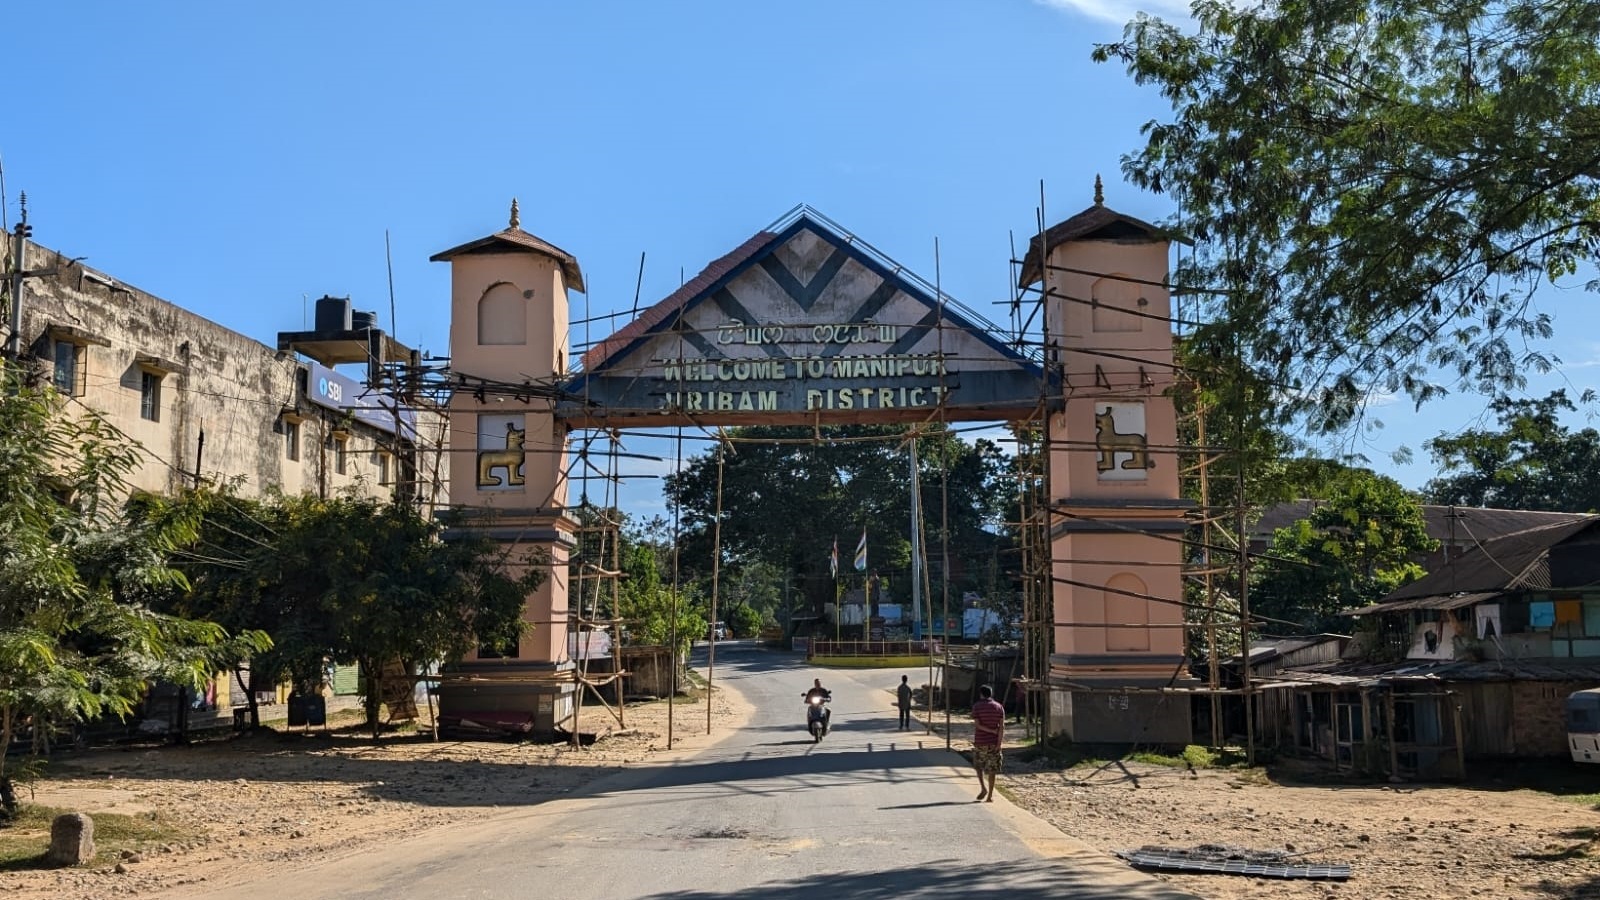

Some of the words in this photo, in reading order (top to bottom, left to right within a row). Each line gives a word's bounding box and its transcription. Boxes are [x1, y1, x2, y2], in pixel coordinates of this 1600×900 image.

[662, 357, 786, 381] WELCOME
[791, 355, 825, 378] TO
[832, 353, 947, 378] MANIPUR
[328, 380, 342, 402] SBI
[807, 385, 948, 410] DISTRICT
